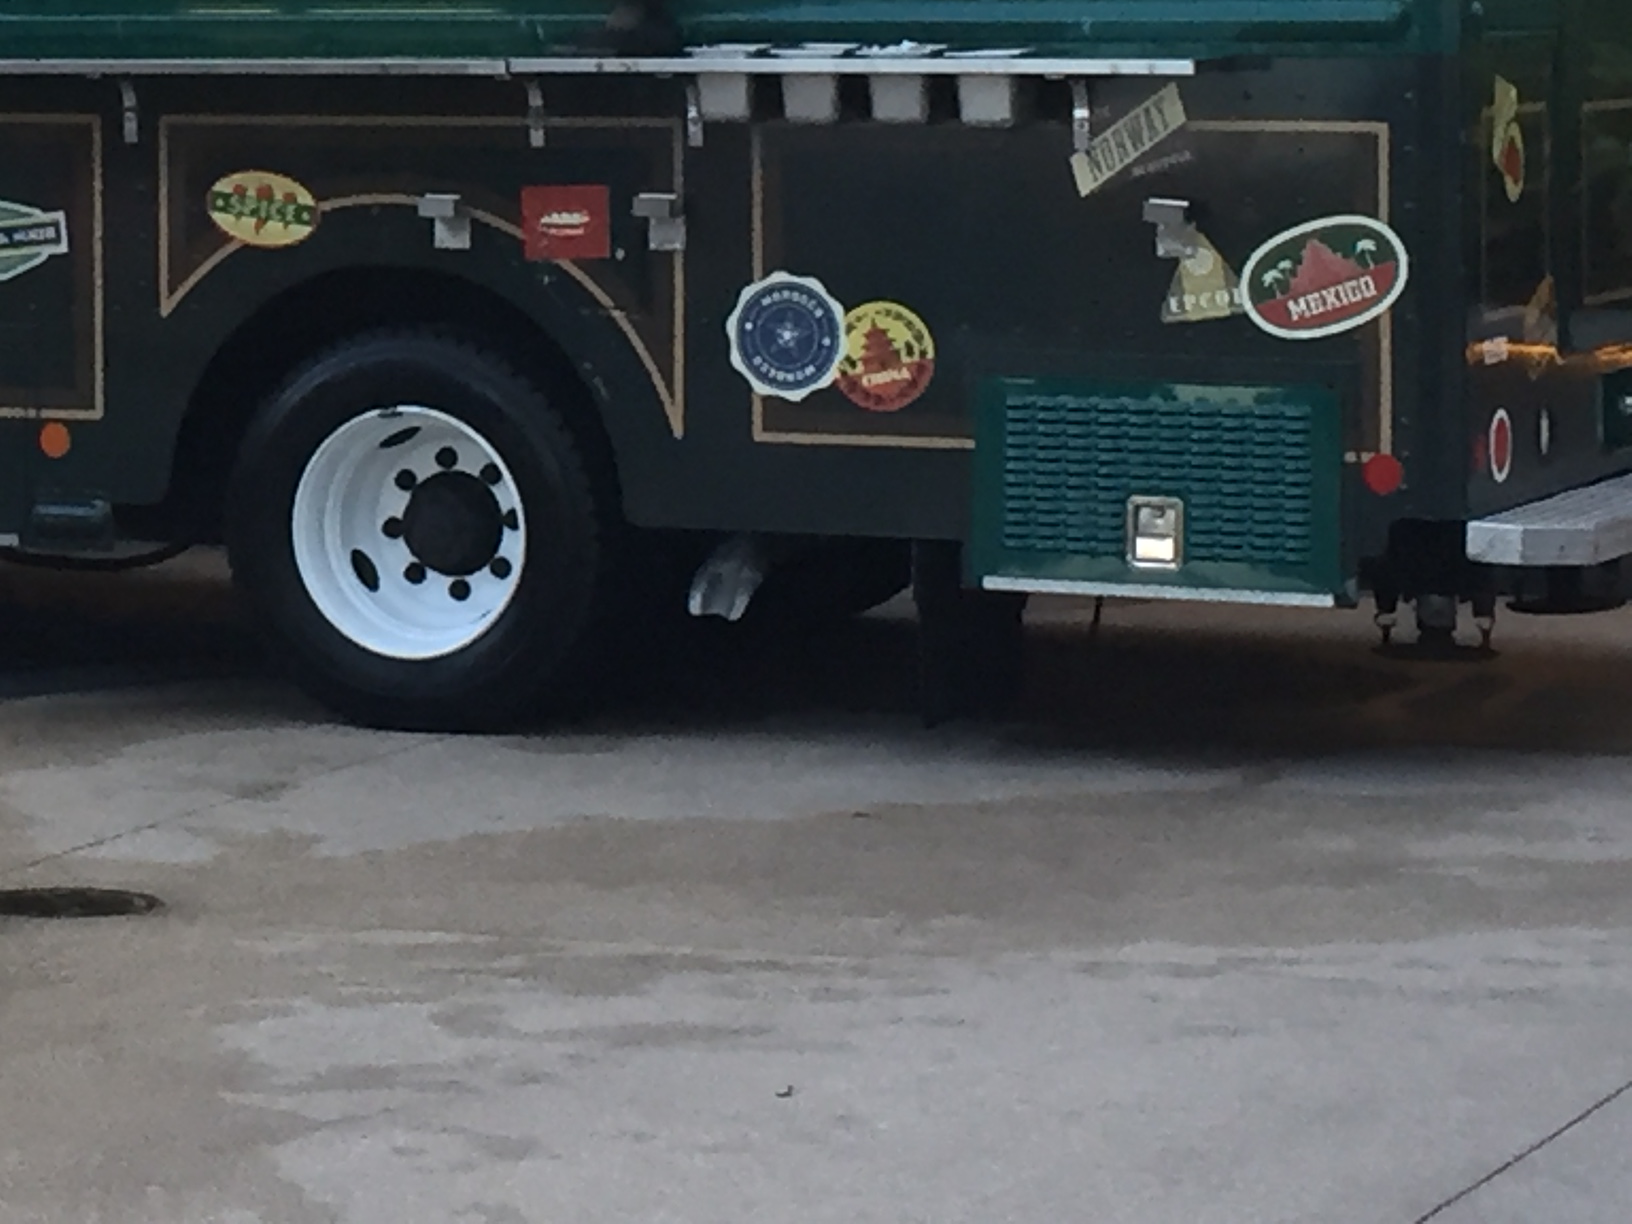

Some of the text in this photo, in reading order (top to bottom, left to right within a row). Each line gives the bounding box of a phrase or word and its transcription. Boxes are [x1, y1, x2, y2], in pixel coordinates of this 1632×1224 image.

[1087, 96, 1173, 183] NORWAY
[229, 195, 298, 224] SPICE
[1286, 274, 1379, 323] MEXICO
